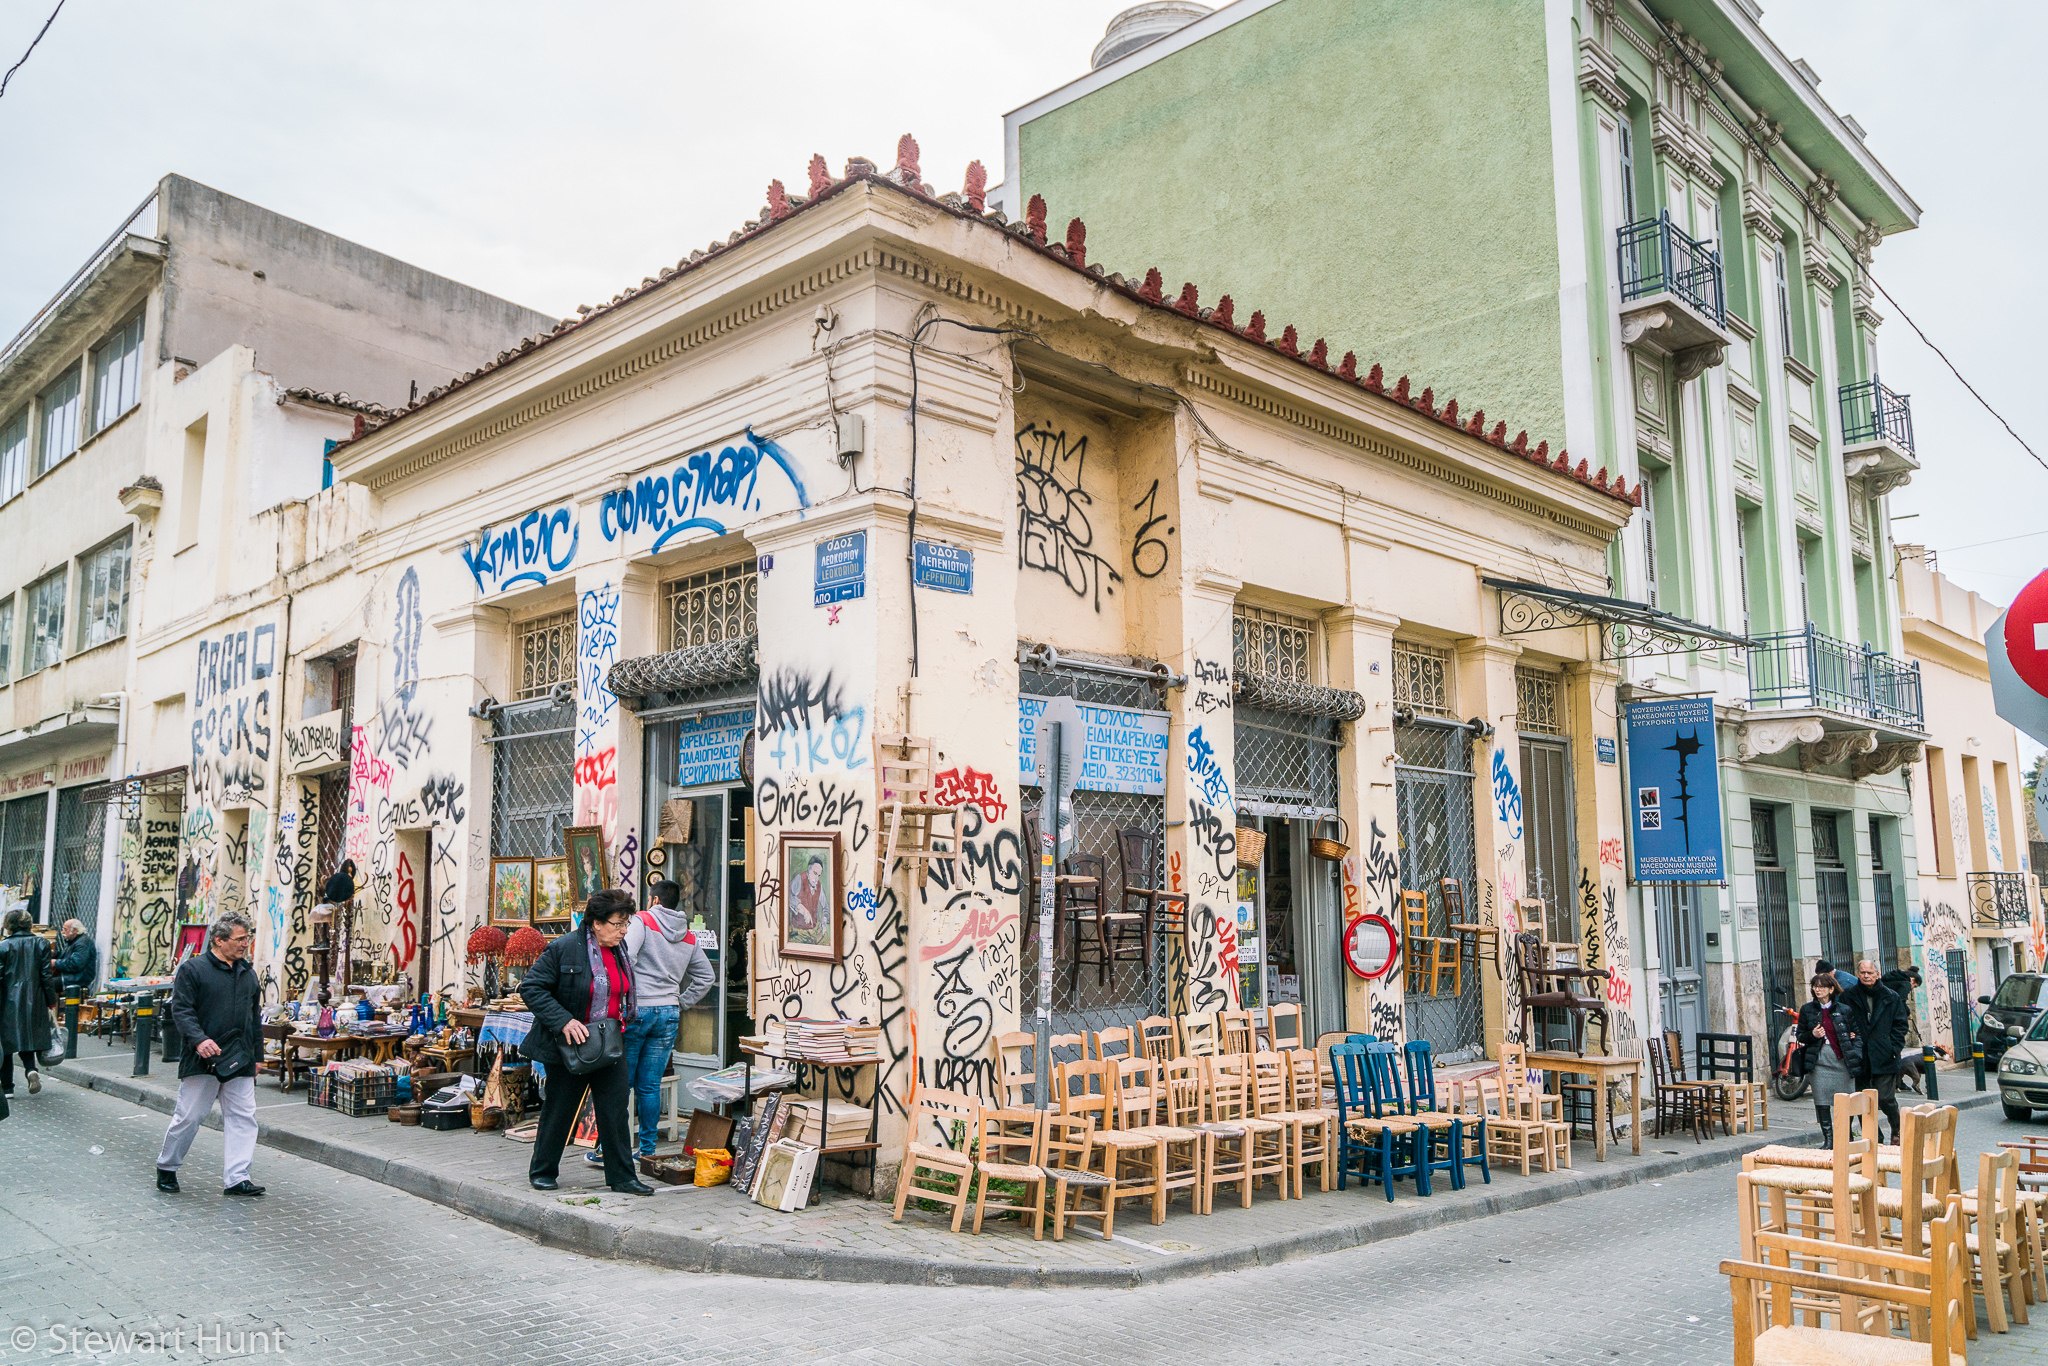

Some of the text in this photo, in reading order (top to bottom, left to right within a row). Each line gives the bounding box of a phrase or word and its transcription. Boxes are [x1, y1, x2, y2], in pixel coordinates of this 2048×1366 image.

[827, 537, 853, 552] ΟΔΟΣ
[929, 545, 959, 560] ΟΔΟΣ
[762, 555, 769, 570] 11
[821, 549, 859, 567] ΛΕΩΚΟΡΙΟΥ
[921, 555, 969, 574] ΛΕΠΕΝΙΩΤΟΥ
[821, 562, 859, 581] LEOKORIOU
[921, 570, 966, 587] LEPENIOTOU
[815, 592, 831, 605] ΑΠΟ
[853, 582, 861, 598] 11
[1632, 702, 1708, 714] ΜΟΥΣΕΙΟ ΑΛΕΞ ΜΥΛΩΝΑ
[1632, 708, 1709, 720] ΜΑΚΕΔΟΝΙΚΟ ΜΟΥΣΕΙΟ
[1632, 716, 1709, 727] ΣΥΓΧΡΟΝΗΣ ΤΕΧΝΗΣ
[679, 731, 721, 749] ΚΑΡΕΚΛΕΣ
[1087, 727, 1112, 744] ΕΙΔΗ
[1114, 729, 1168, 750] ΚΑΡΕΚΛΩΝ
[1090, 745, 1160, 767] ΕΠΙΣΚΕΥΕΣ
[1115, 765, 1163, 784] 3231194
[146, 820, 179, 833] 2016
[144, 849, 175, 862] SPOOK
[1651, 868, 1704, 876] CONTEMPORARY
